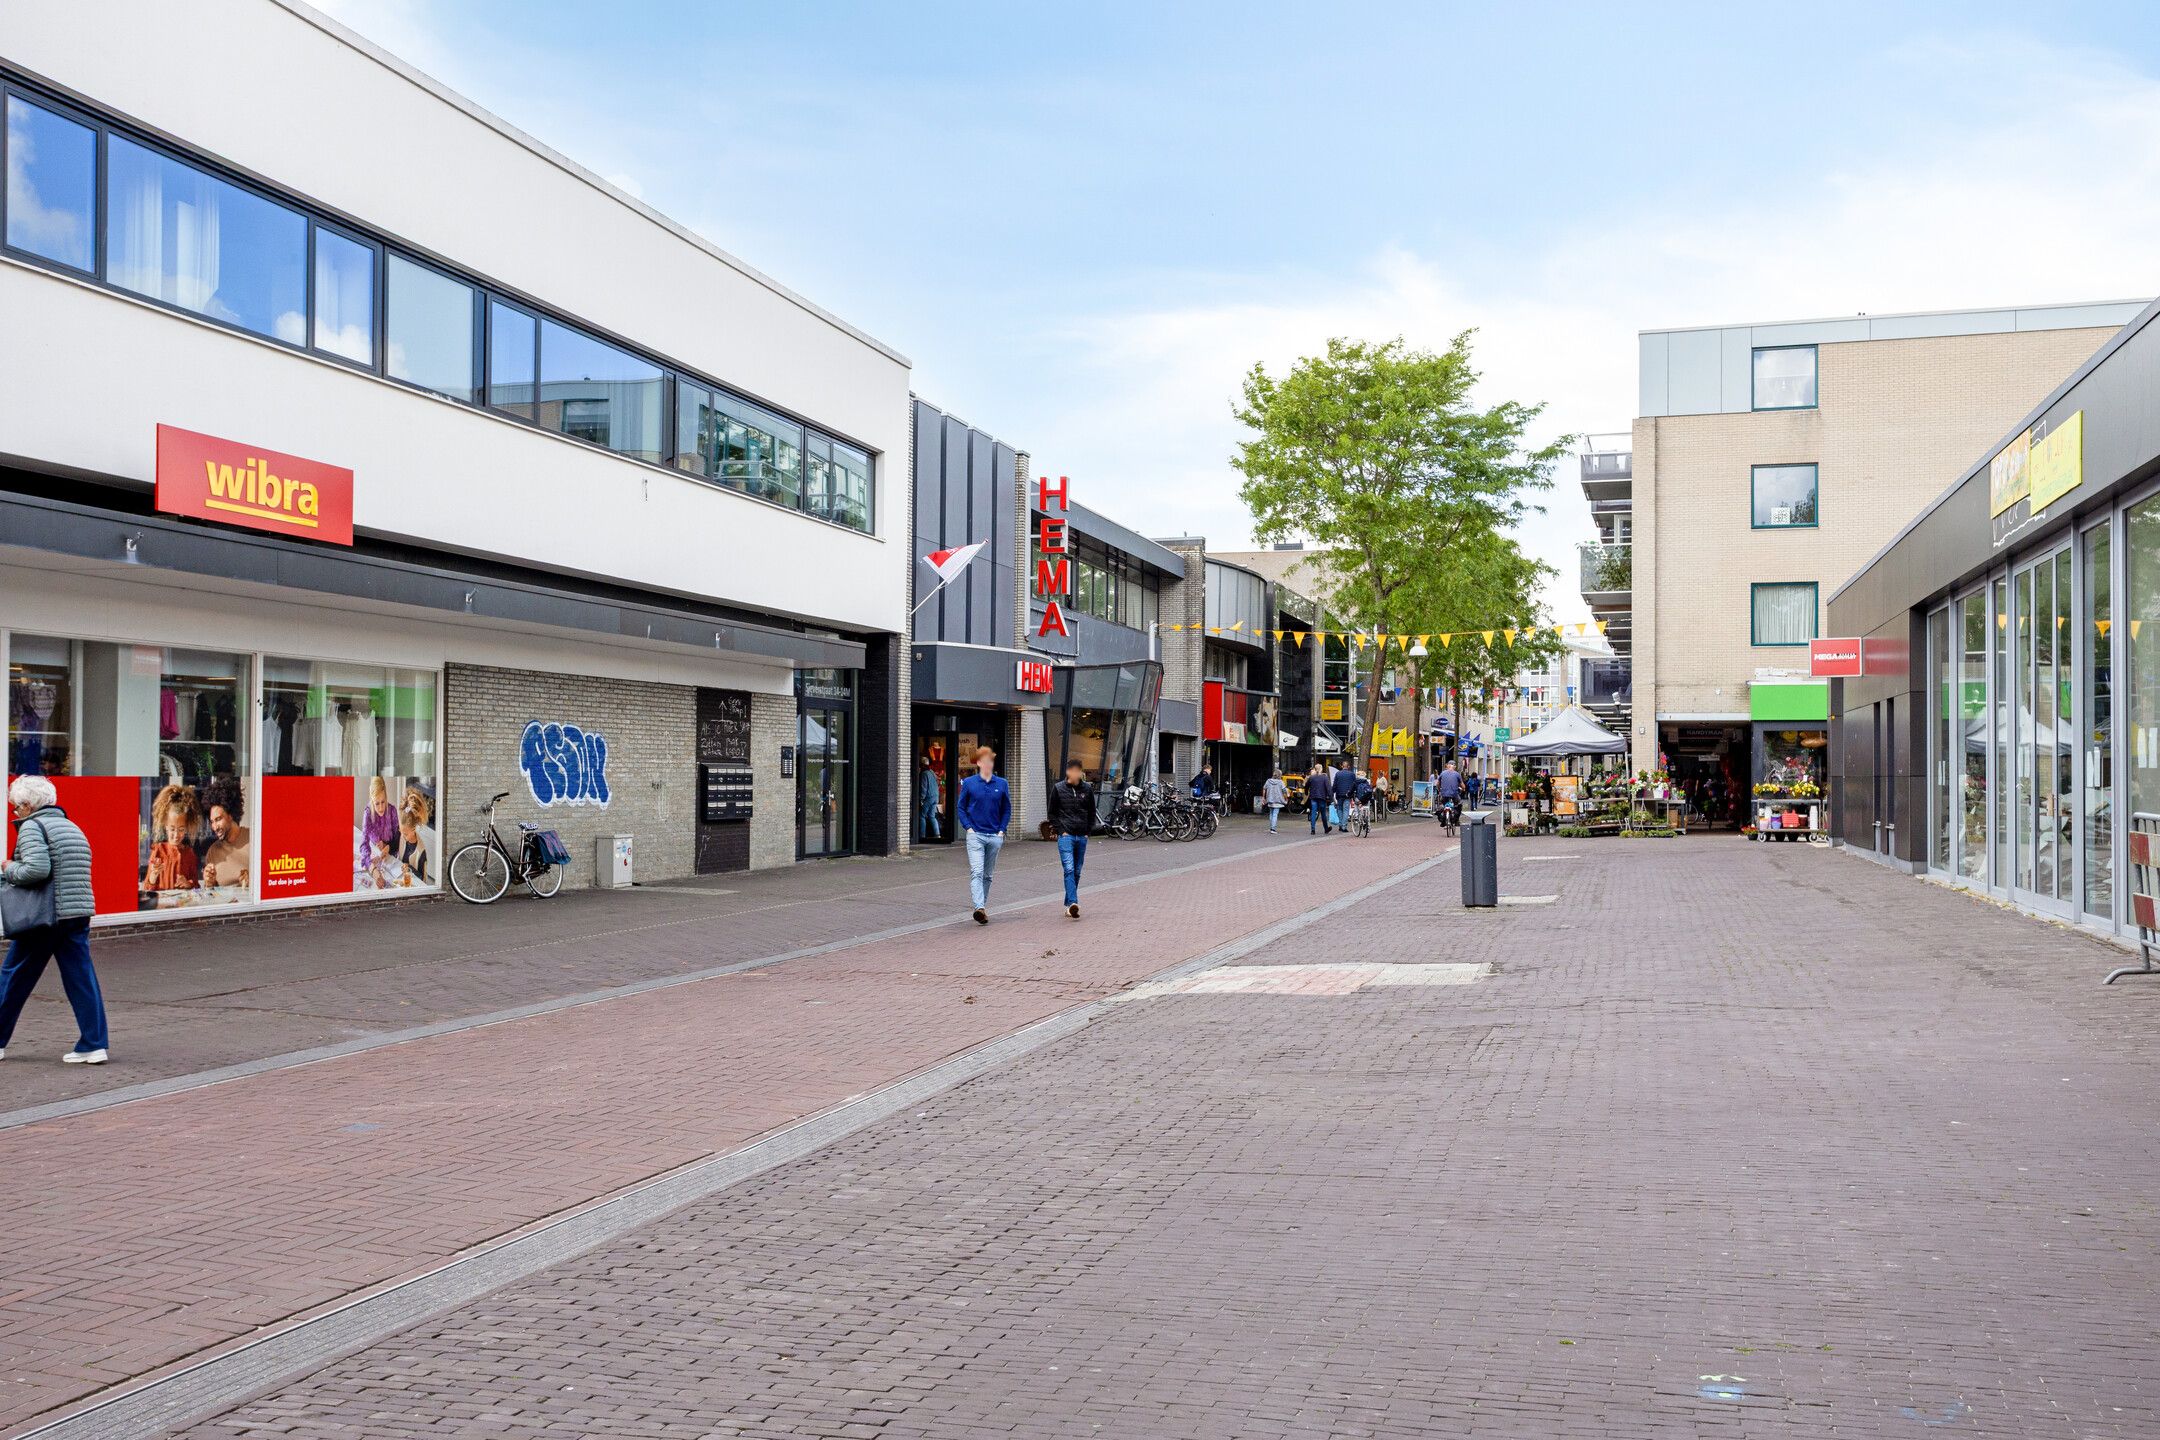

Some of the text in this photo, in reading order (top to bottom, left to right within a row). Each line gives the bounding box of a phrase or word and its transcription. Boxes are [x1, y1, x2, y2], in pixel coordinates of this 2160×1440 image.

[205, 457, 318, 516] wibra
[1037, 476, 1070, 637] HEMA
[1814, 653, 1838, 661] MEGA
[269, 854, 306, 871] wibra
